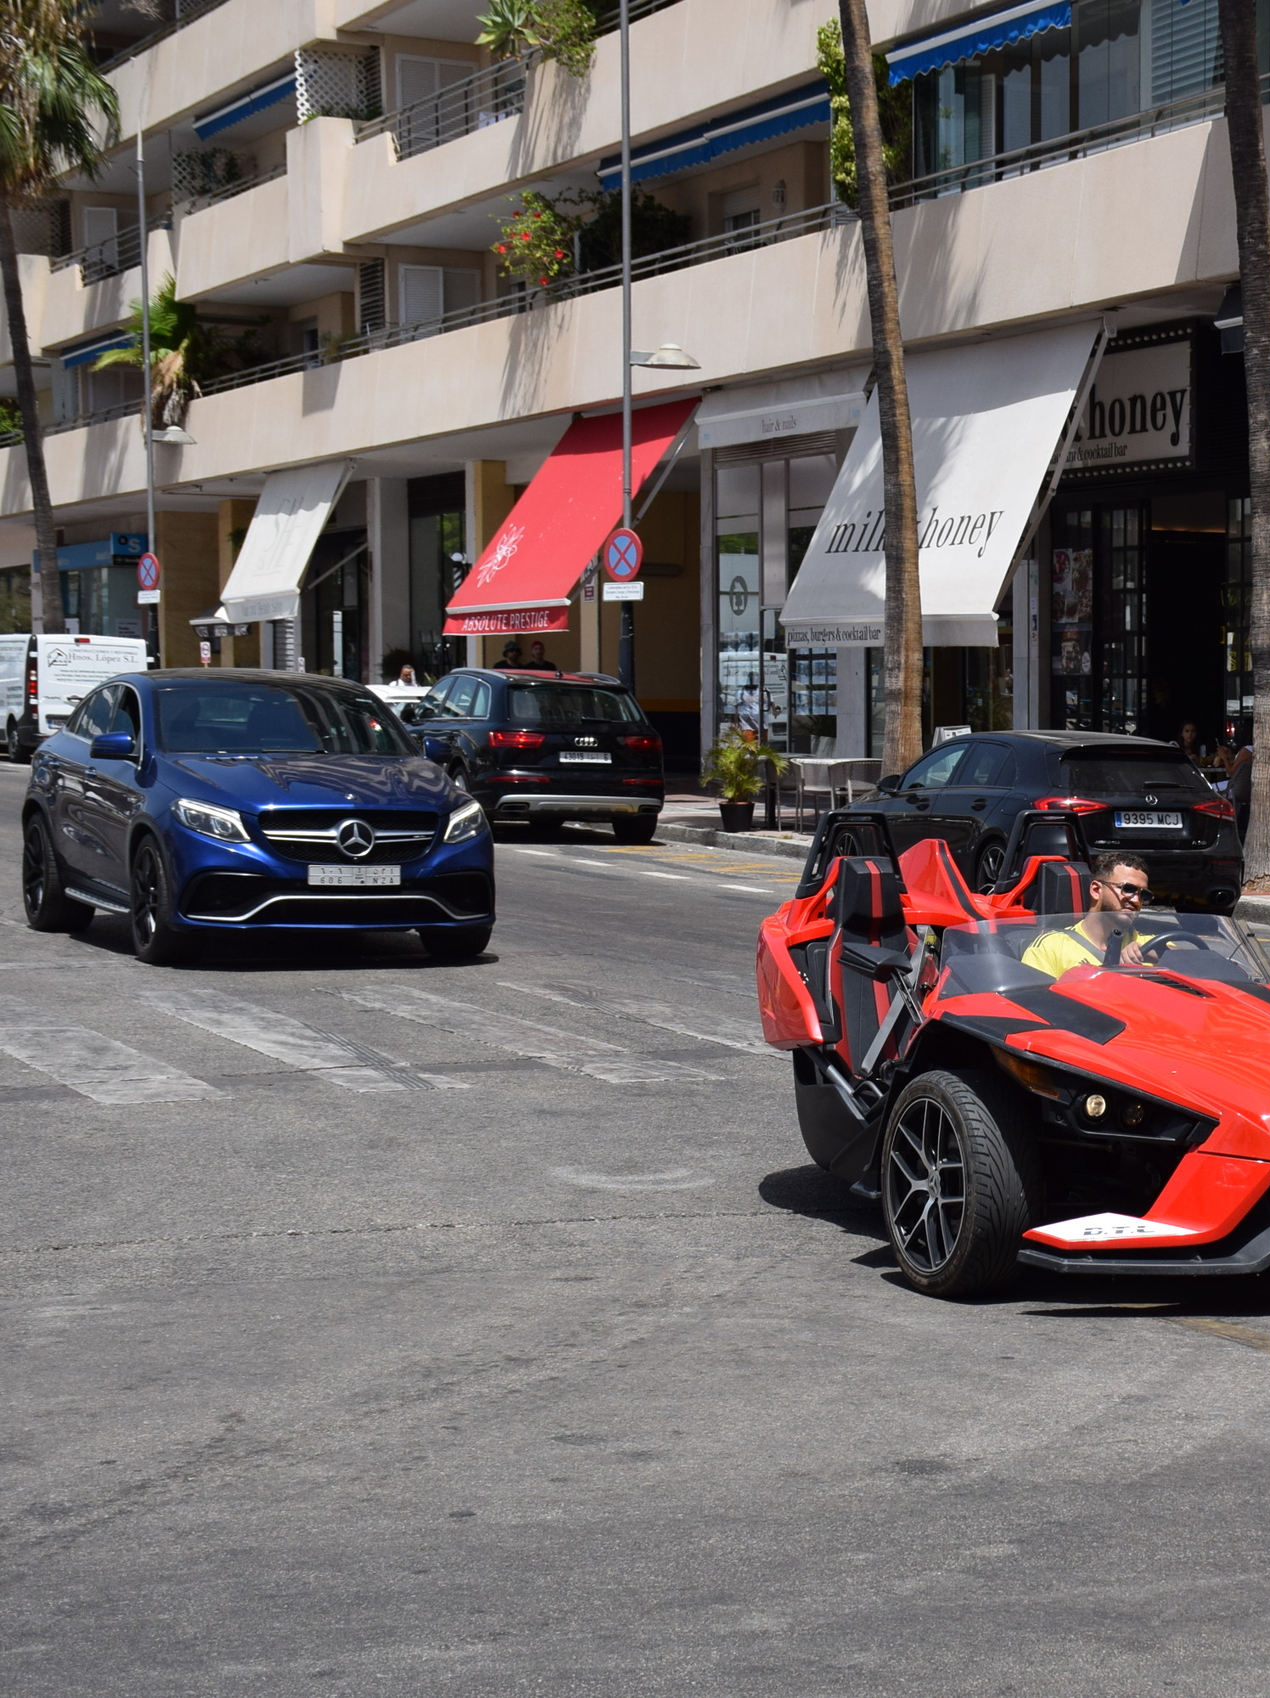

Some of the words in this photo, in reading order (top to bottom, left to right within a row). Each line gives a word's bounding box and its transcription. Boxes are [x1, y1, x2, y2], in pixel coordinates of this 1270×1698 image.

[761, 418, 774, 433] hair
[774, 419, 780, 432] &
[782, 415, 798, 430] nails
[1088, 383, 1188, 447] honey
[1084, 442, 1113, 460] cocktail
[1114, 442, 1127, 458] bar
[918, 505, 1005, 558] honey
[461, 614, 508, 631] ABSOLUTE
[509, 610, 550, 629] PRESTIGE
[810, 627, 836, 646] burgers
[836, 627, 842, 642] &
[842, 626, 868, 642] cocktail
[868, 625, 881, 640] bar
[96, 653, 121, 664] López
[1123, 813, 1154, 825] 9395
[1157, 814, 1179, 826] MCJ
